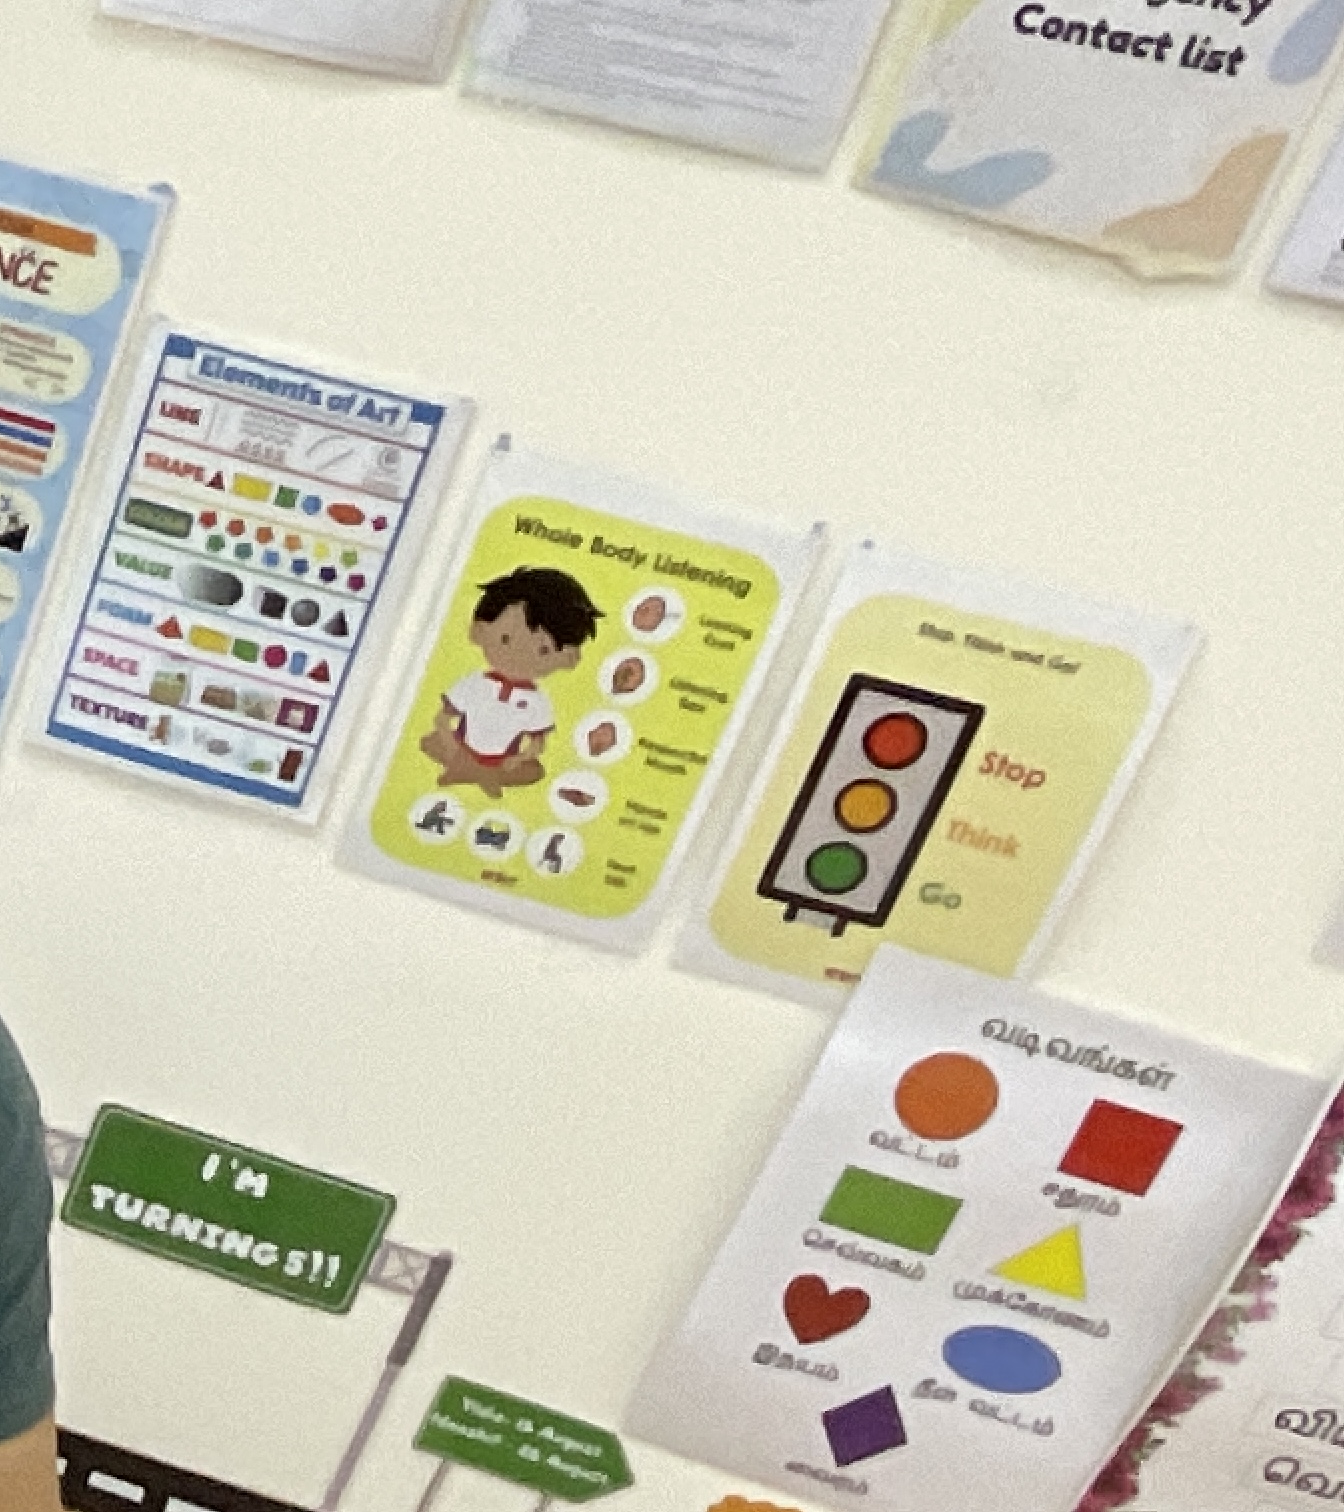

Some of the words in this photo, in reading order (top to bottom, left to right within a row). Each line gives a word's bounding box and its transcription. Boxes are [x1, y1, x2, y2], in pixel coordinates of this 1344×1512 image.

[1011, 2, 1173, 63] Contact
[1179, 33, 1247, 77] list
[200, 355, 323, 407] Elements
[326, 391, 358, 419] of
[358, 397, 402, 429] Art
[158, 400, 203, 428] LINE
[143, 450, 206, 485] SHAPE
[113, 549, 174, 582] VALUE
[513, 512, 583, 551] Whole
[590, 534, 649, 570] Body
[653, 554, 753, 600] Listening
[96, 598, 154, 627] FORM
[83, 645, 141, 679] SPACE
[977, 751, 1047, 790] Stop
[945, 817, 1022, 860] Think
[918, 881, 963, 911] Go
[201, 1152, 270, 1199] I'M
[90, 1182, 280, 1267] TURNING
